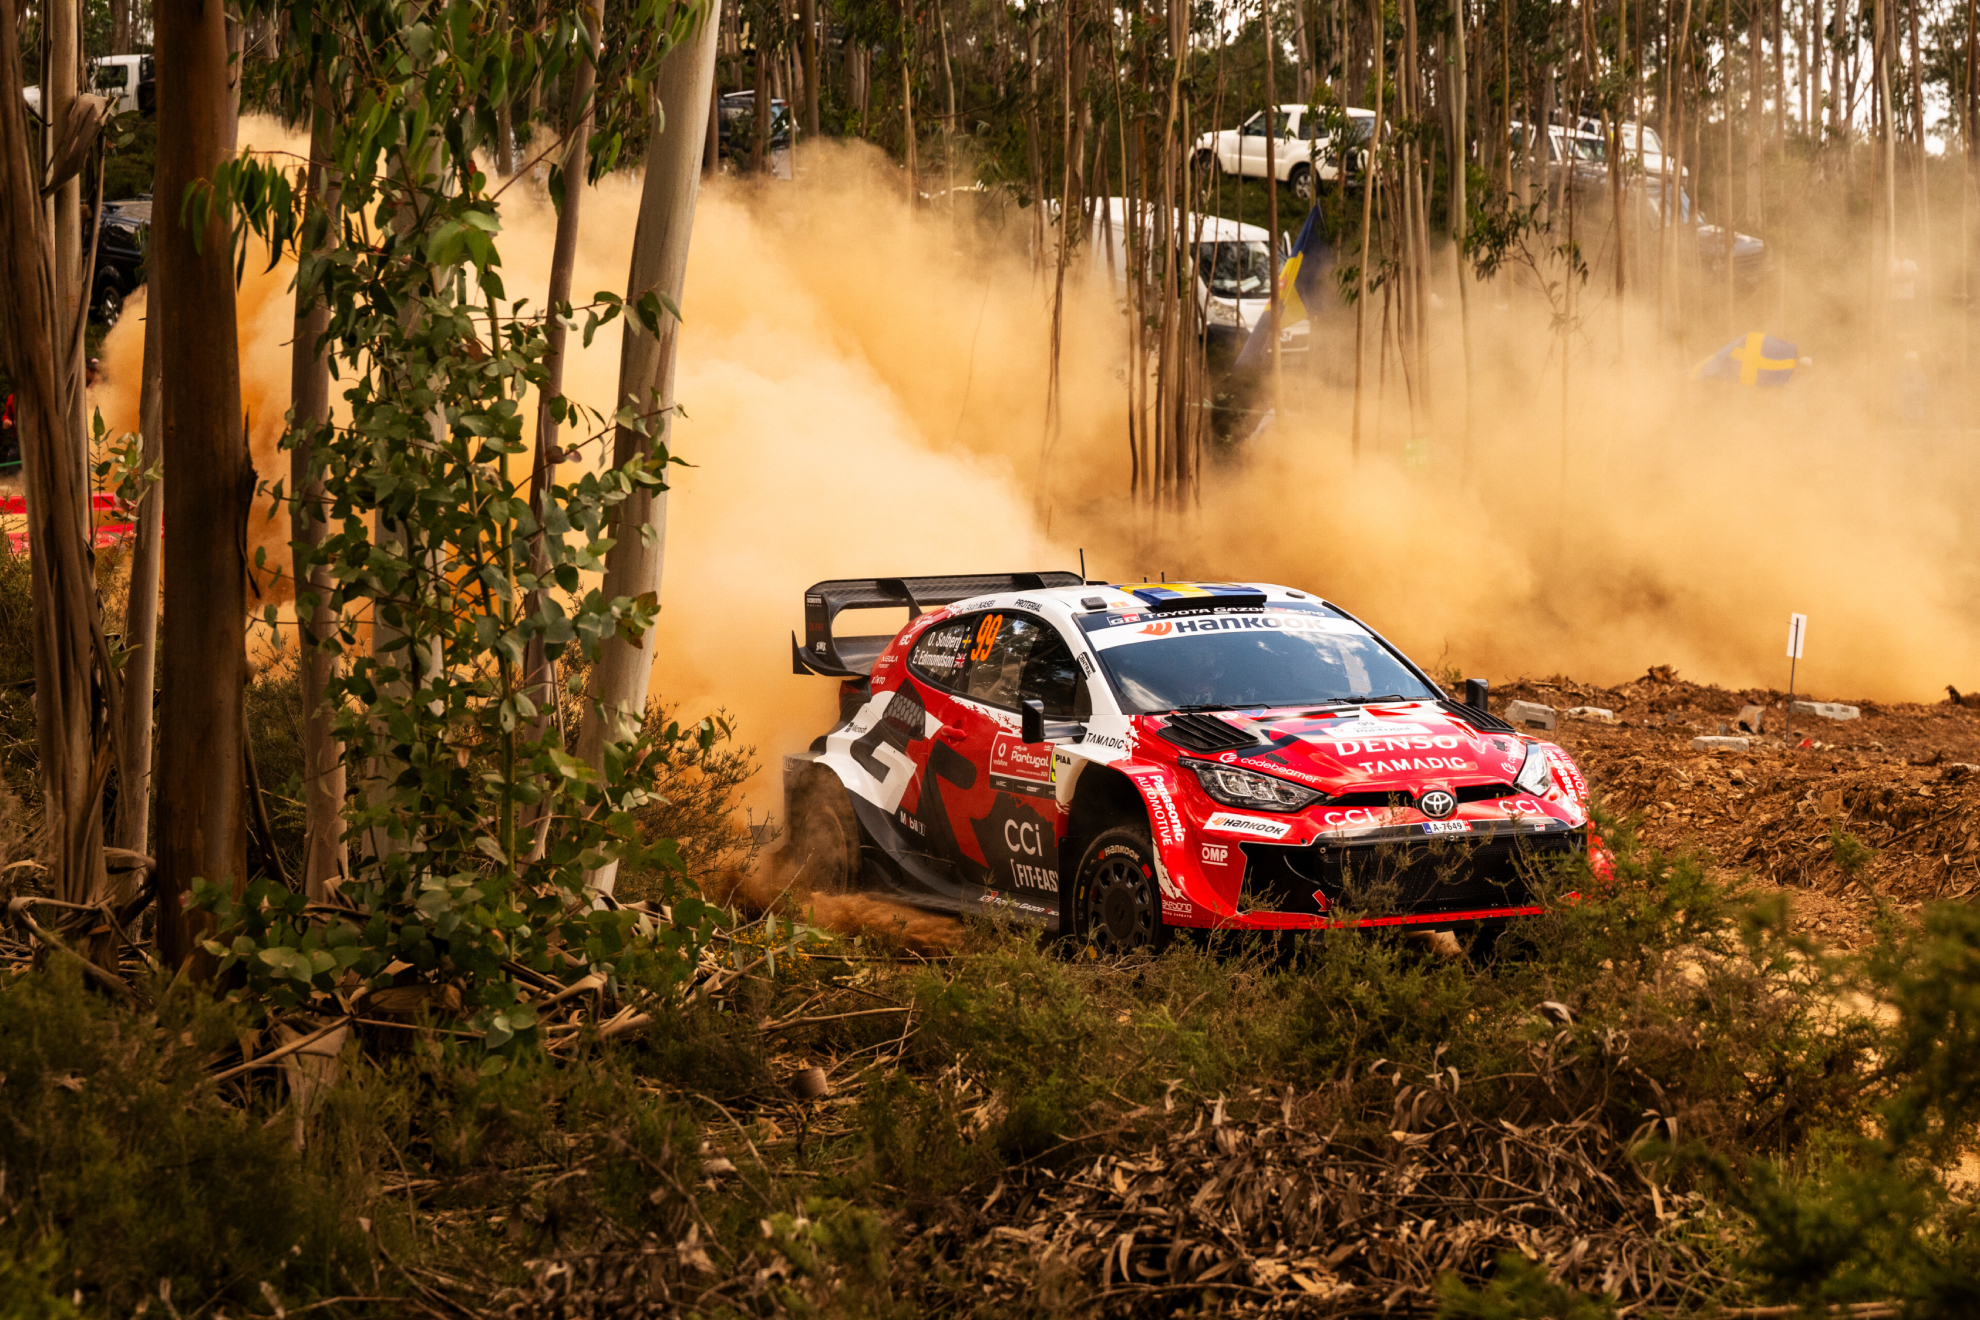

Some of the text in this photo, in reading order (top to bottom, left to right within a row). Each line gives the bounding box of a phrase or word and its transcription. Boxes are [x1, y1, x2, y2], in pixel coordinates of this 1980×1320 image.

[1144, 608, 1210, 619] TOYOTA
[1213, 606, 1270, 614] GAZOO
[935, 632, 962, 652] Solberg
[970, 613, 1003, 662] 99
[918, 651, 955, 668] Edmondson
[1087, 732, 1125, 750] TAMADIC
[1333, 735, 1458, 757] DENSO
[1011, 750, 1049, 768] Portugal
[1056, 754, 1071, 765] PIAA
[1359, 757, 1467, 775] TAMADIC
[1240, 757, 1320, 784] codebeamer
[1135, 775, 1173, 846] AUTOMOTIVE
[1149, 774, 1185, 843] Panasonic
[1433, 821, 1463, 831] A-7649
[1202, 847, 1229, 863] OMP
